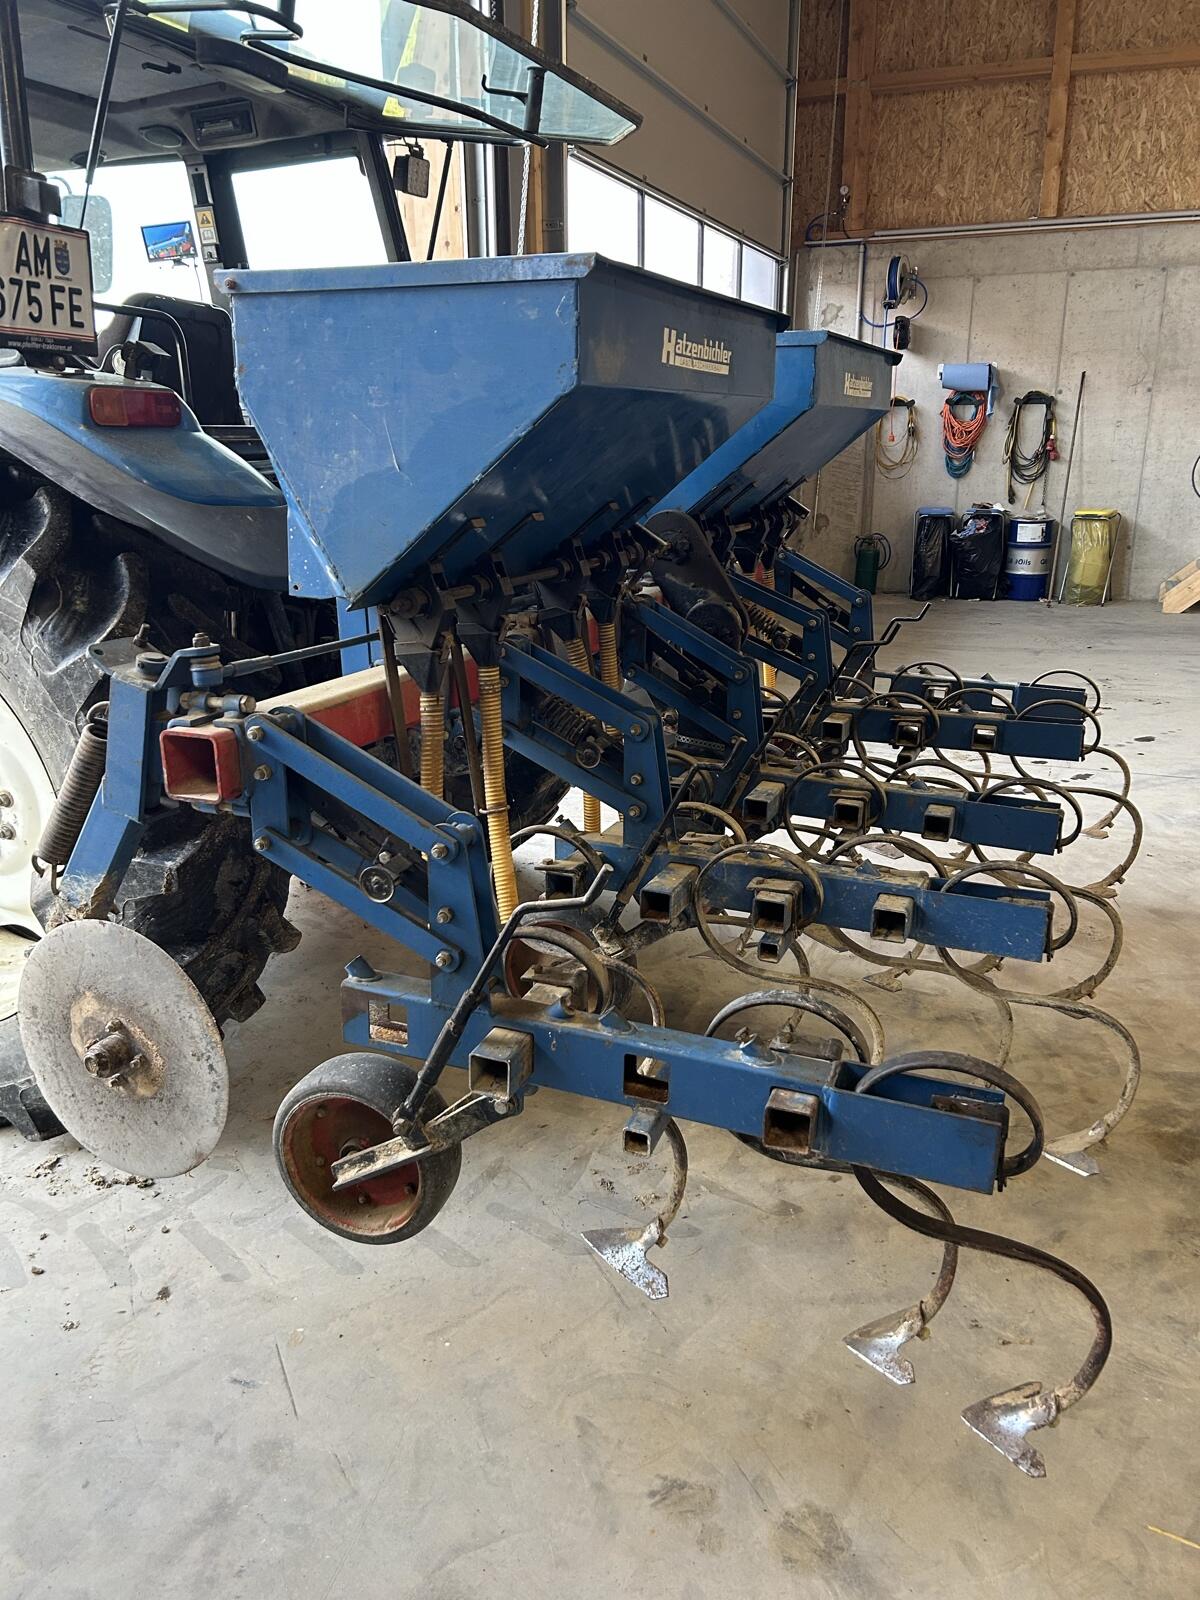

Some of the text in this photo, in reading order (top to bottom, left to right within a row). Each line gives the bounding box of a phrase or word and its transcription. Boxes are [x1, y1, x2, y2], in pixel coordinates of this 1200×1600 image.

[16, 231, 51, 279] AM
[50, 284, 84, 328] FE
[661, 327, 732, 366] Hatzenbichler
